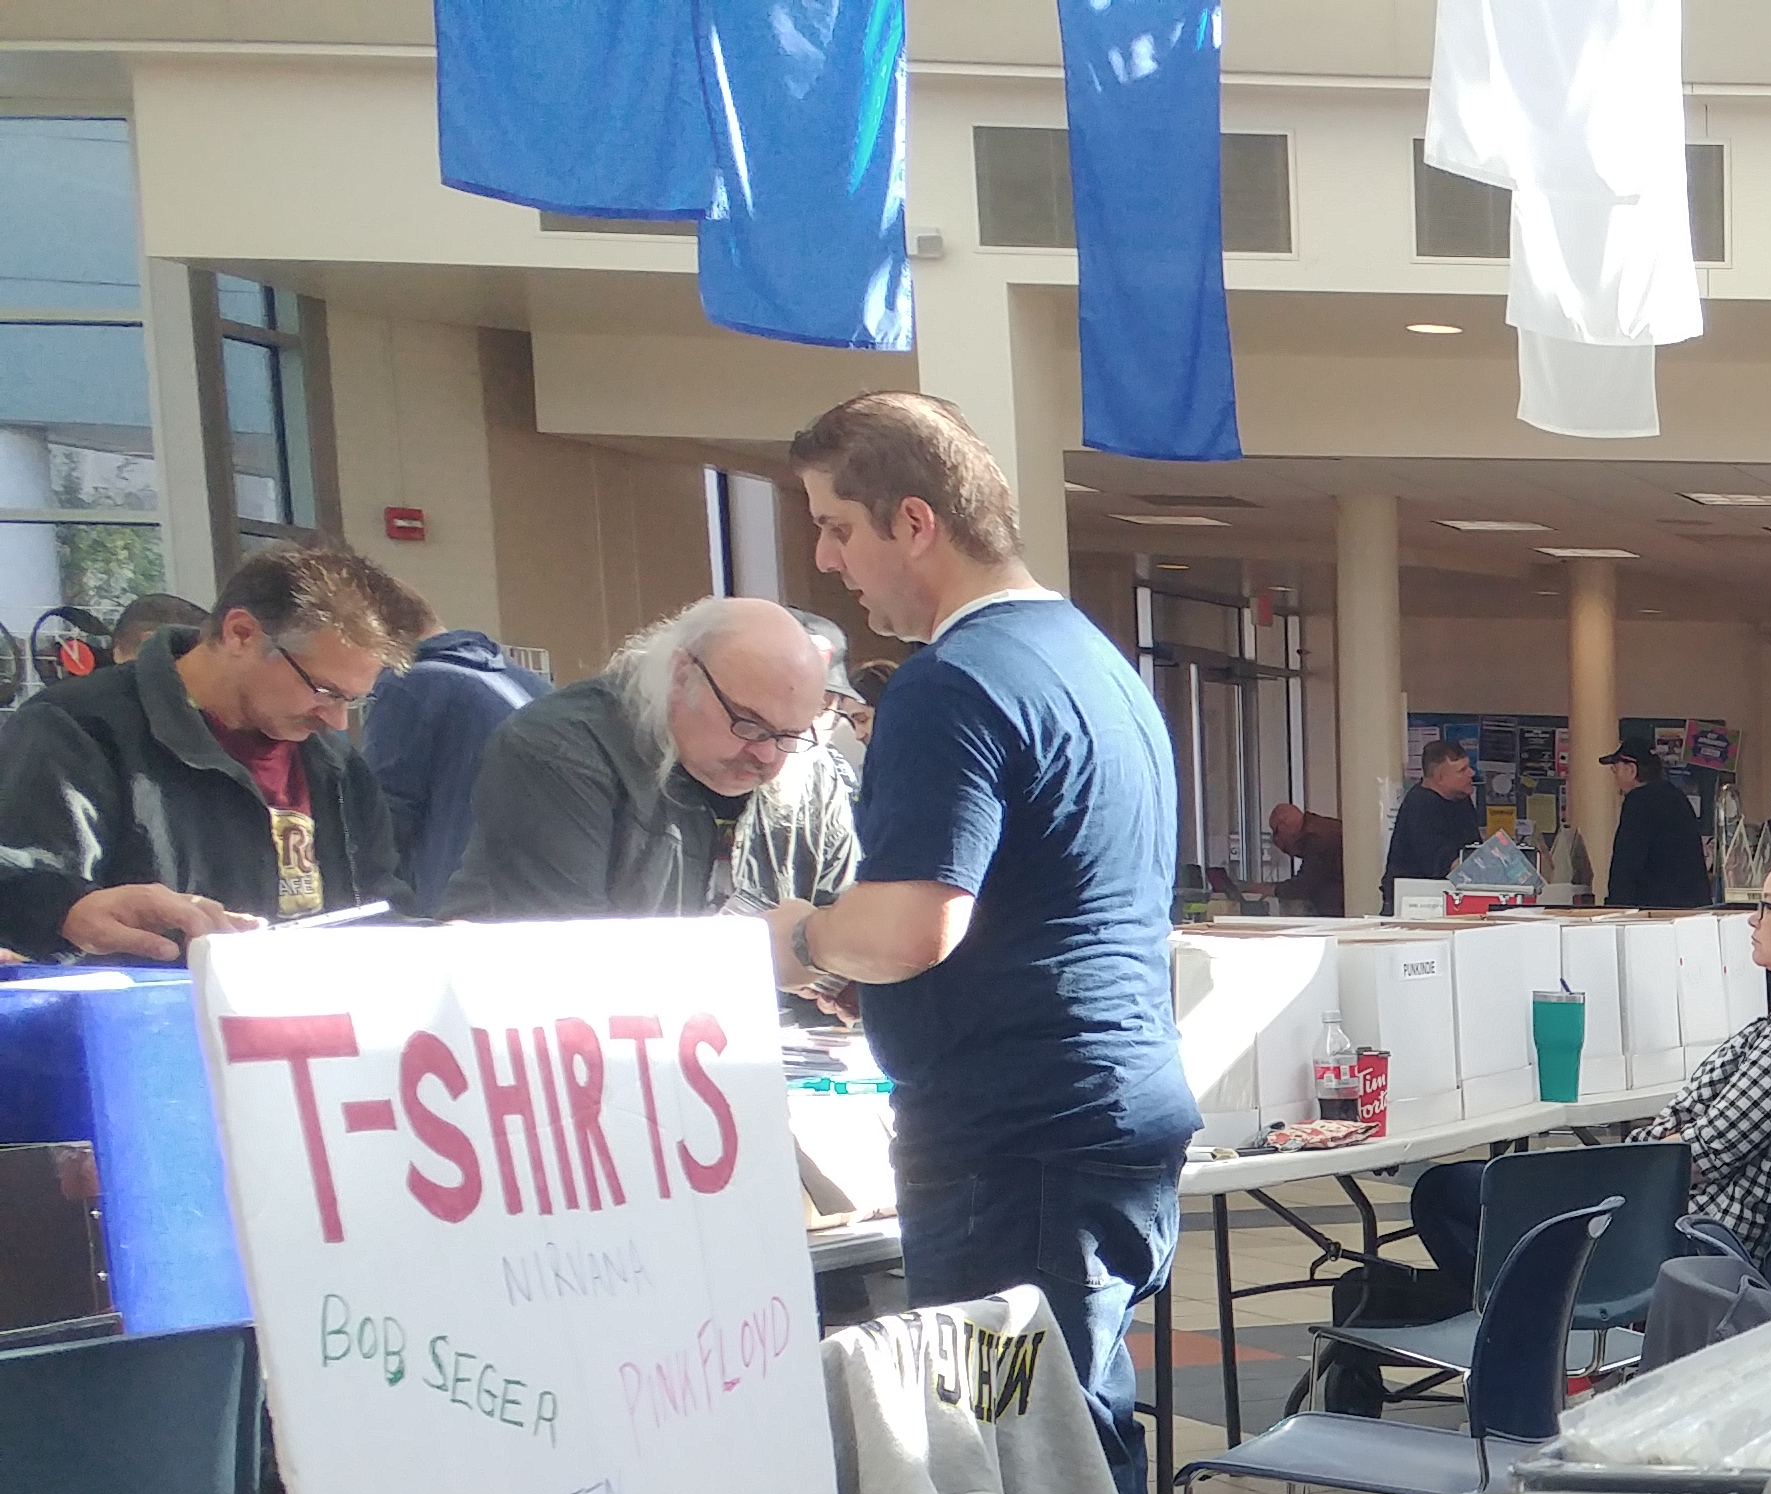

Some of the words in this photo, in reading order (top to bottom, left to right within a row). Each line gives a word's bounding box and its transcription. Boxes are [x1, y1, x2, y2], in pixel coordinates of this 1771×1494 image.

[279, 878, 314, 896] AFE
[219, 1013, 738, 1244] T-SHIRTS
[1355, 1068, 1386, 1096] Tim
[501, 1238, 652, 1306] NIRVANA
[321, 1294, 406, 1387] BOB
[422, 1335, 559, 1449] SEGER
[618, 1350, 698, 1457] PINK
[697, 1295, 790, 1413] FLOYD
